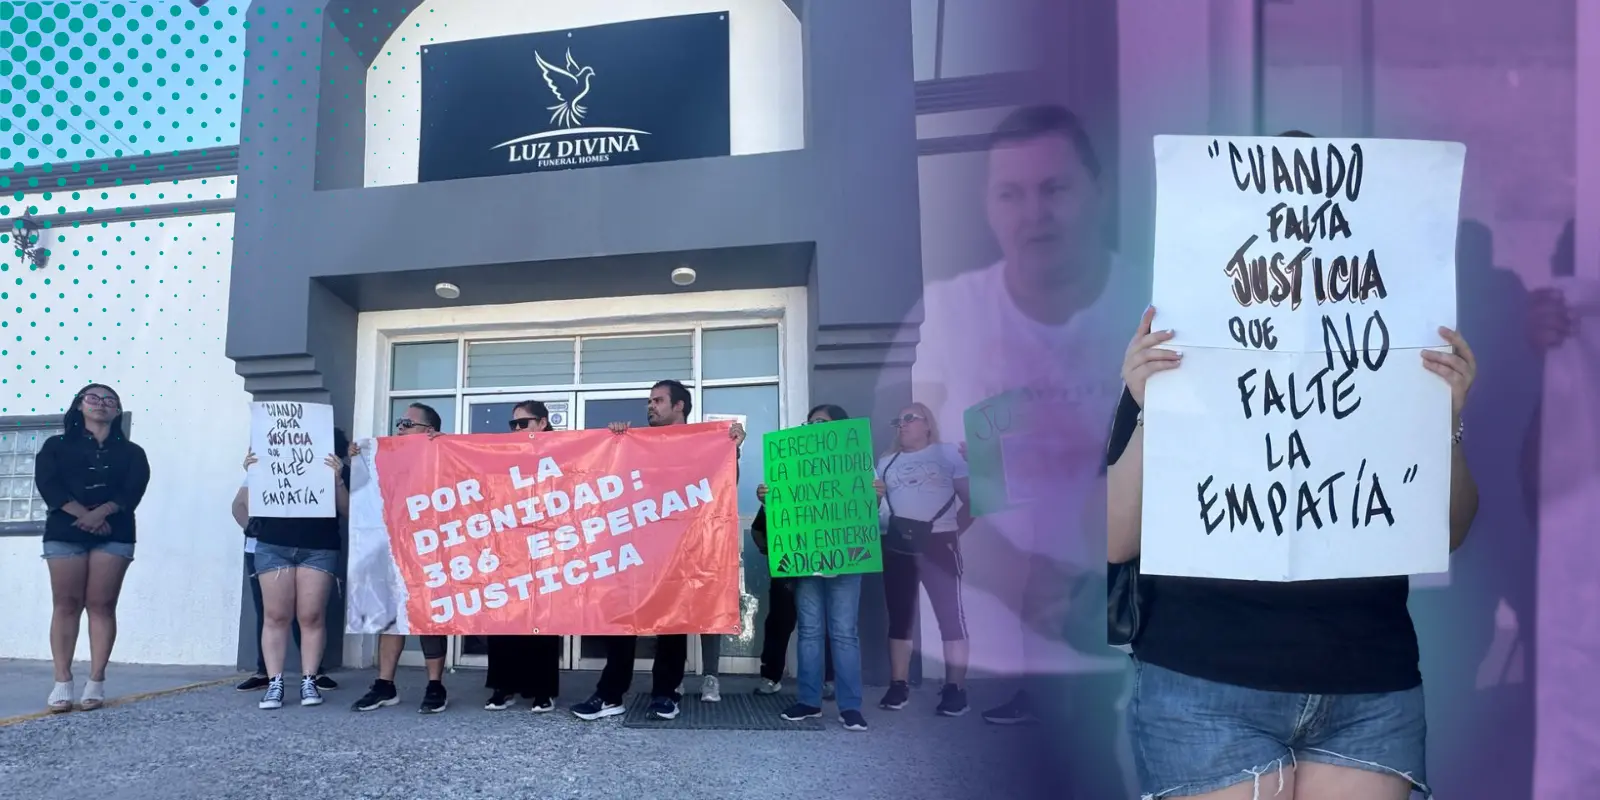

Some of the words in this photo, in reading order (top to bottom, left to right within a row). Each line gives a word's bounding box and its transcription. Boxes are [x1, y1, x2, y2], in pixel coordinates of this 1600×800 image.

[509, 142, 551, 162] LUZ
[557, 134, 640, 157] DIVINA
[538, 157, 577, 167] FUNERAL
[579, 154, 609, 164] HOMES
[1208, 140, 1363, 201] "CUANDO
[1267, 198, 1352, 243] FALTA
[1224, 235, 1388, 311] JUSTICIA
[1229, 316, 1278, 350] QUE
[1322, 310, 1390, 374] NO
[1238, 368, 1361, 419] FALTE
[267, 427, 312, 446] JUSTICIA
[277, 417, 300, 429] FALTA
[268, 448, 280, 457] QUE
[292, 448, 314, 464] NO
[769, 430, 837, 461] DERECHO
[846, 427, 860, 447] A
[1266, 429, 1311, 472] LA
[271, 462, 306, 475] FALTE
[278, 478, 291, 488] LA
[770, 462, 788, 482] LA
[406, 478, 484, 521] POR
[509, 457, 563, 489] LA
[771, 487, 782, 504] A
[788, 479, 843, 504] VOLVER
[852, 476, 865, 495] A
[412, 469, 645, 556] DIGNIDAD:
[772, 508, 791, 529] LA
[866, 500, 874, 520] Y
[422, 547, 500, 588] 386
[527, 477, 714, 560] ESPERAN
[773, 534, 784, 553] A
[789, 532, 807, 551] UN
[815, 525, 878, 549] ENTIERRO
[794, 550, 845, 573] DIGNO
[430, 542, 645, 623] JUSTICIA
